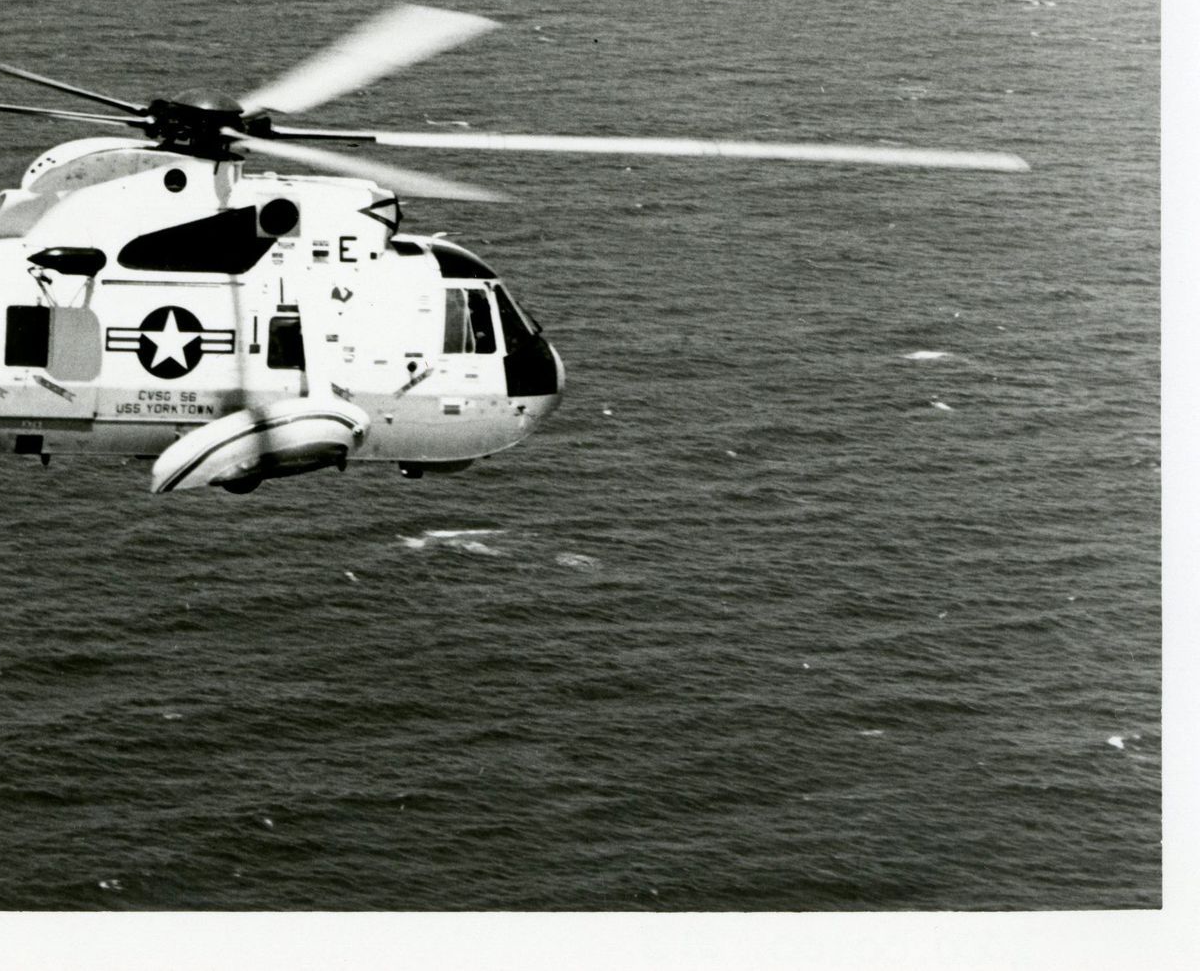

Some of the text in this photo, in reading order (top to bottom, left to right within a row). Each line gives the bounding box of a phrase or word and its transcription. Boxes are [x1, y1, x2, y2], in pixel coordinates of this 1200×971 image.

[339, 236, 357, 262] E
[138, 390, 197, 402] CVSG 56
[115, 403, 214, 415] USS YORKTOWN
